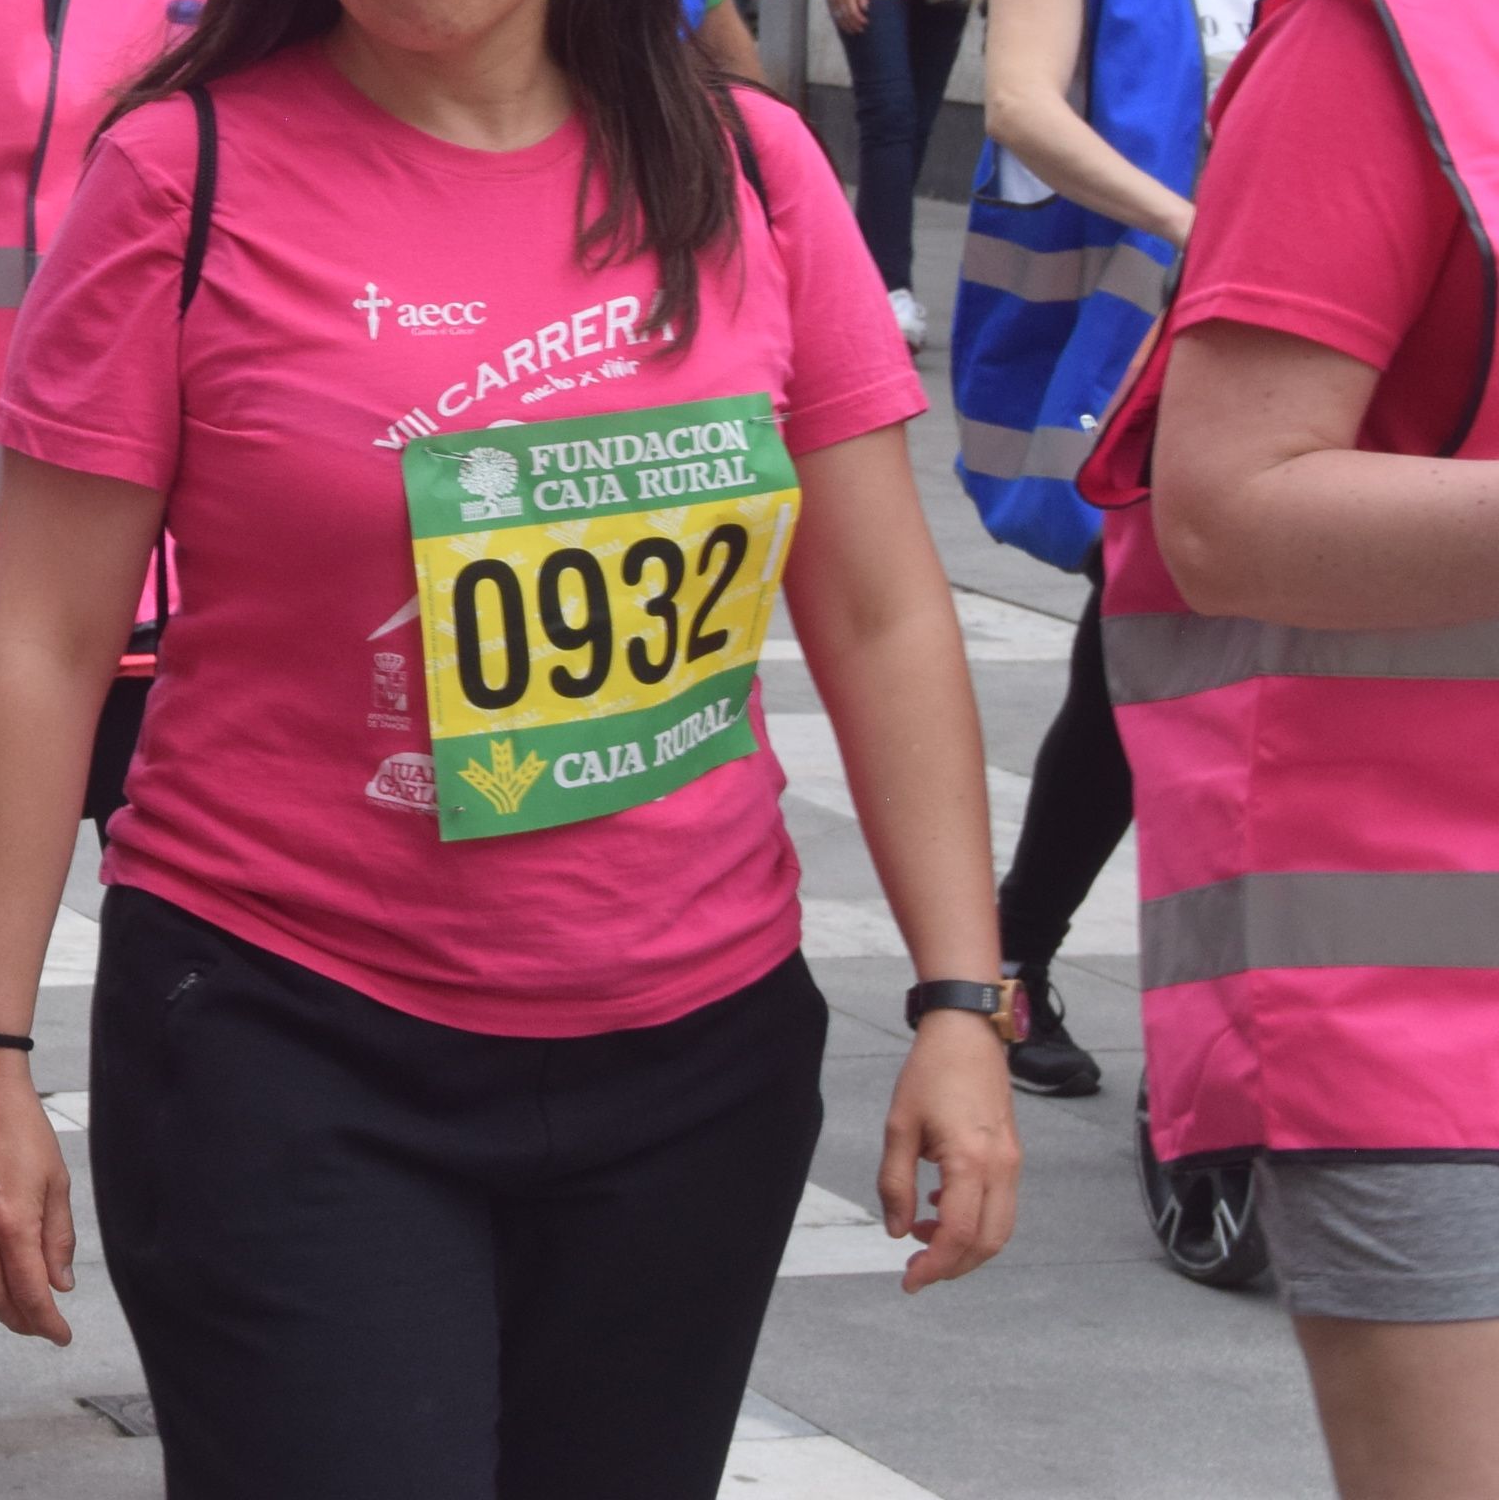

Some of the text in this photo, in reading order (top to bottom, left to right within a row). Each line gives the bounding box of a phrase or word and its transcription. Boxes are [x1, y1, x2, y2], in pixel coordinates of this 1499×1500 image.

[397, 301, 487, 327] aecc
[437, 296, 675, 417] CARRER
[528, 420, 749, 475] FUNDACION
[533, 455, 756, 512] CAJA RURAL
[453, 523, 748, 710] 0932
[554, 698, 735, 789] CAJA RURAL
